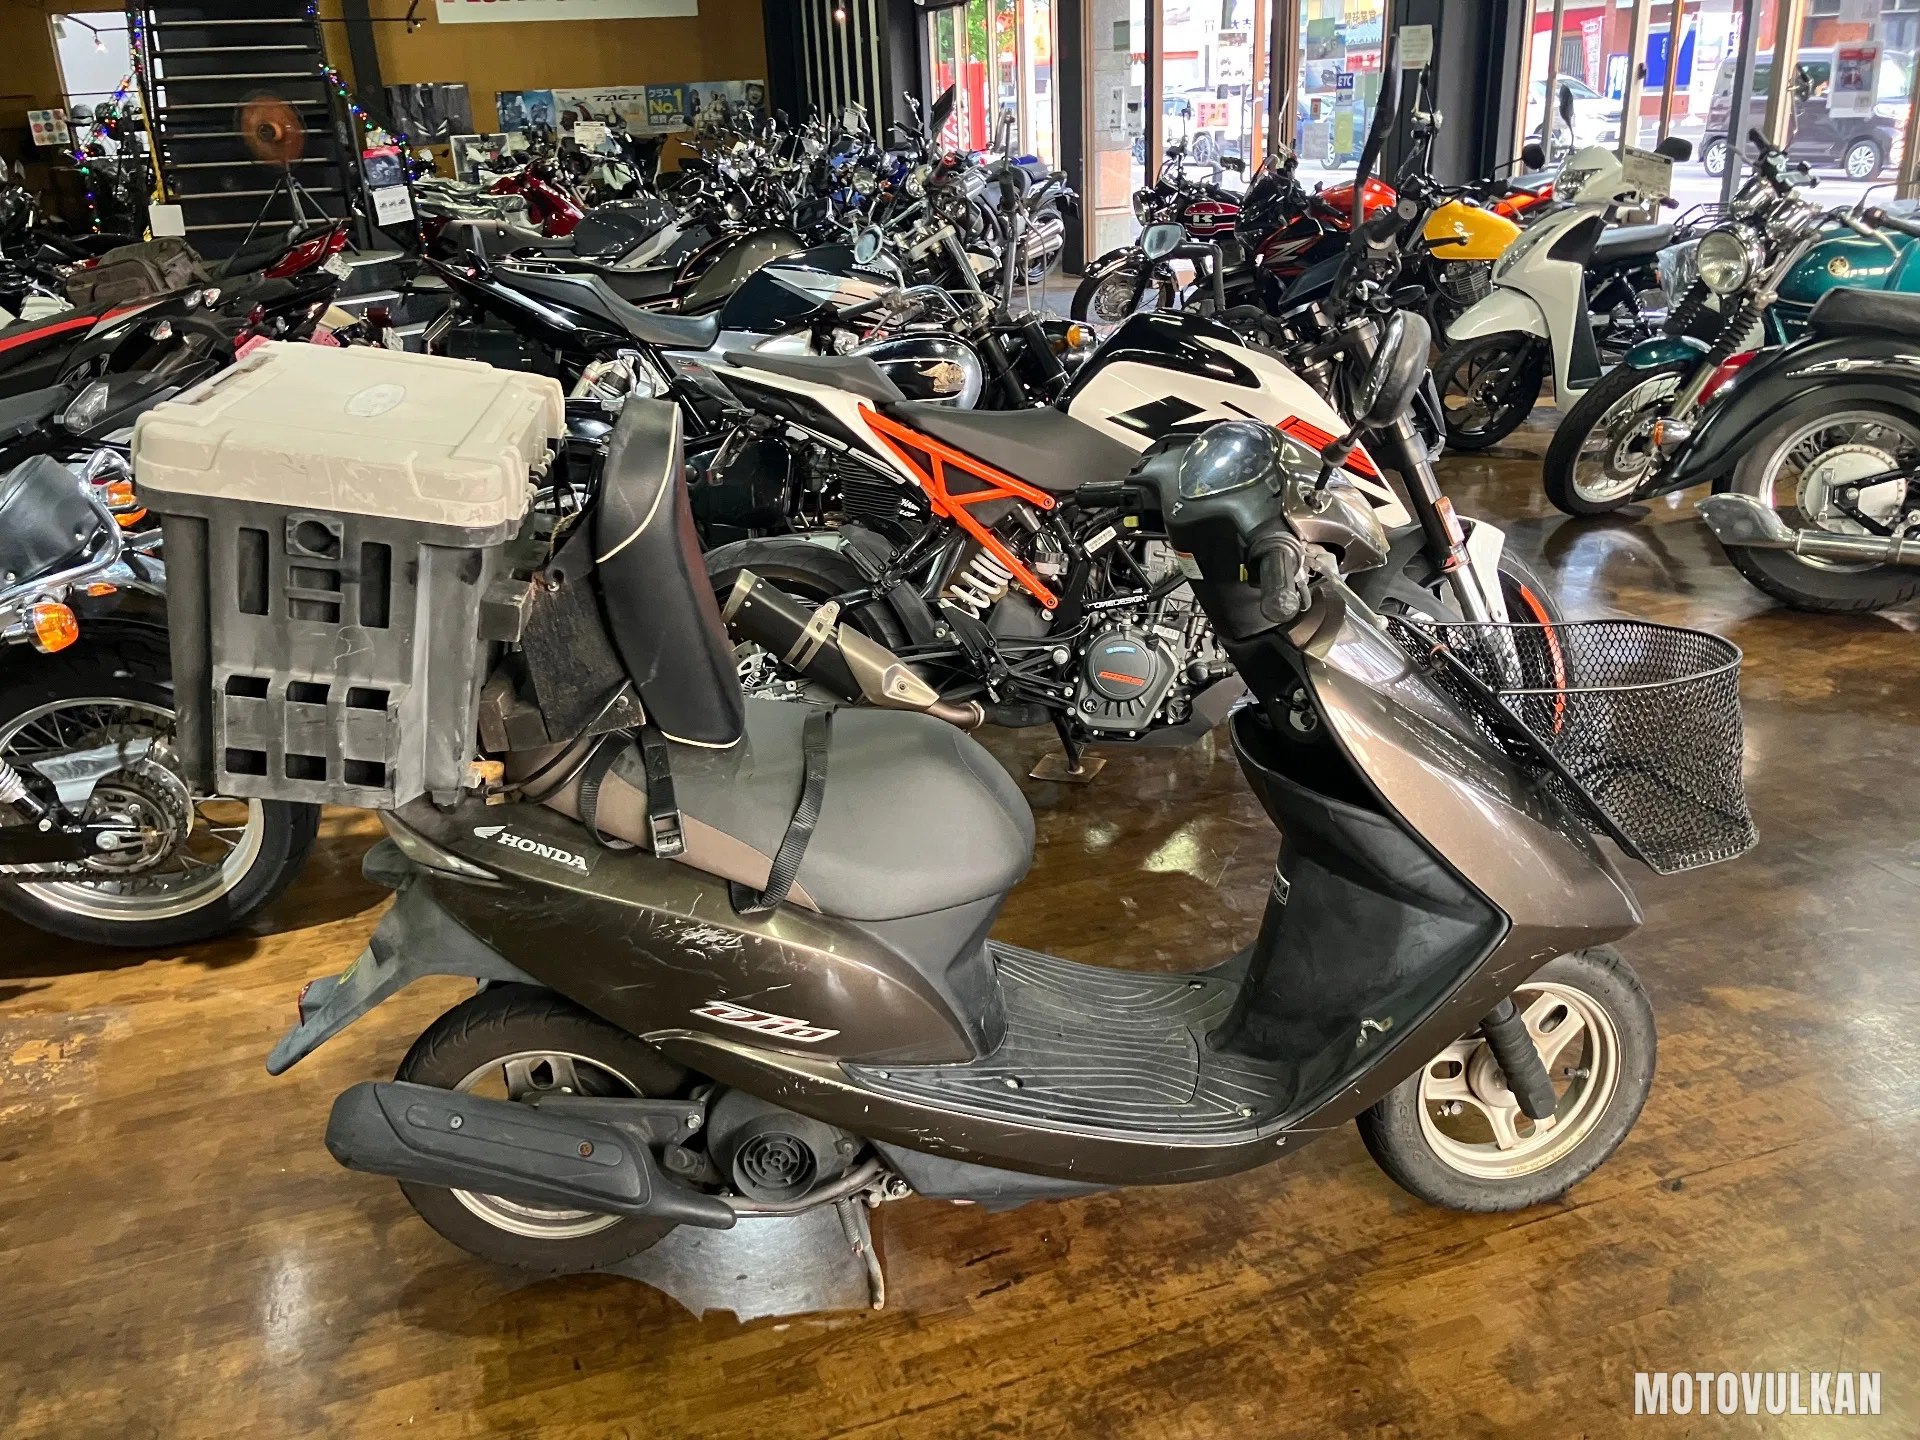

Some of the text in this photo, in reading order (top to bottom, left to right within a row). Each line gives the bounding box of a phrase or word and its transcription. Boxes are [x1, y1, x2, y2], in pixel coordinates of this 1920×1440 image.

[1337, 75, 1353, 87] ETC
[593, 93, 643, 102] TACT
[648, 88, 673, 98] クラス
[649, 88, 684, 115] No.1
[851, 263, 897, 282] HONDA
[497, 832, 588, 871] HONDA
